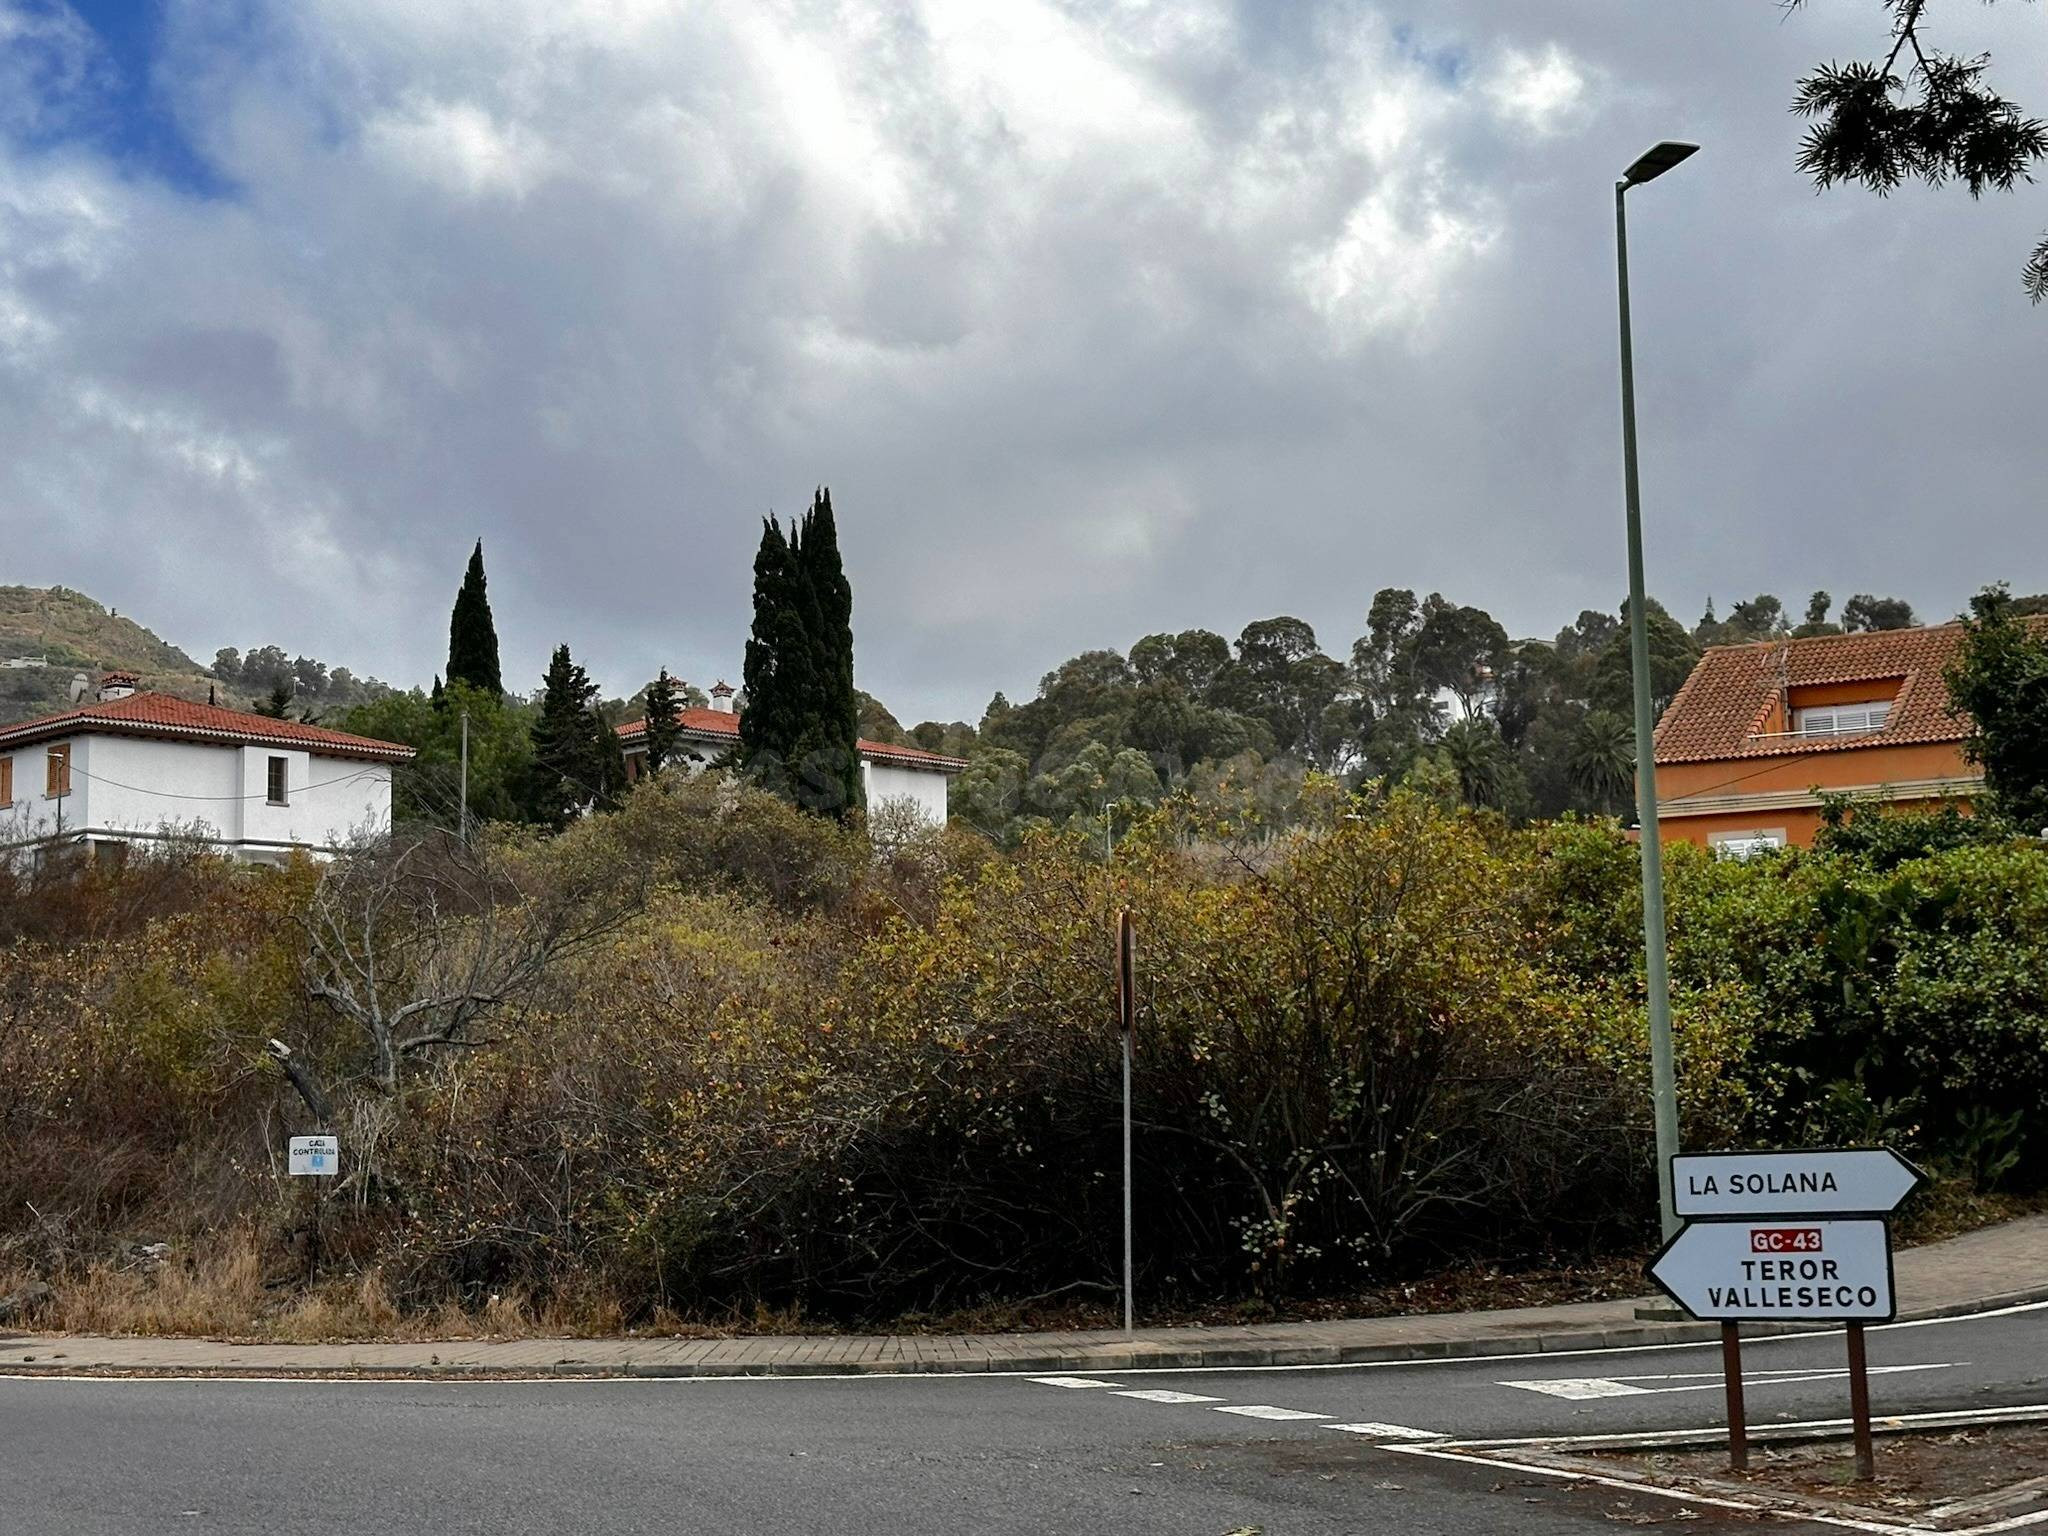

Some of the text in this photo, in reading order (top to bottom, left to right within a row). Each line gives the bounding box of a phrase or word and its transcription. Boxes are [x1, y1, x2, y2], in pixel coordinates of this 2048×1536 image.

[1689, 1172, 1838, 1195] LA SOLANA
[1753, 1231, 1821, 1250] GC-43
[1741, 1259, 1839, 1281] TEROR
[1708, 1286, 1877, 1308] VALLESECO
